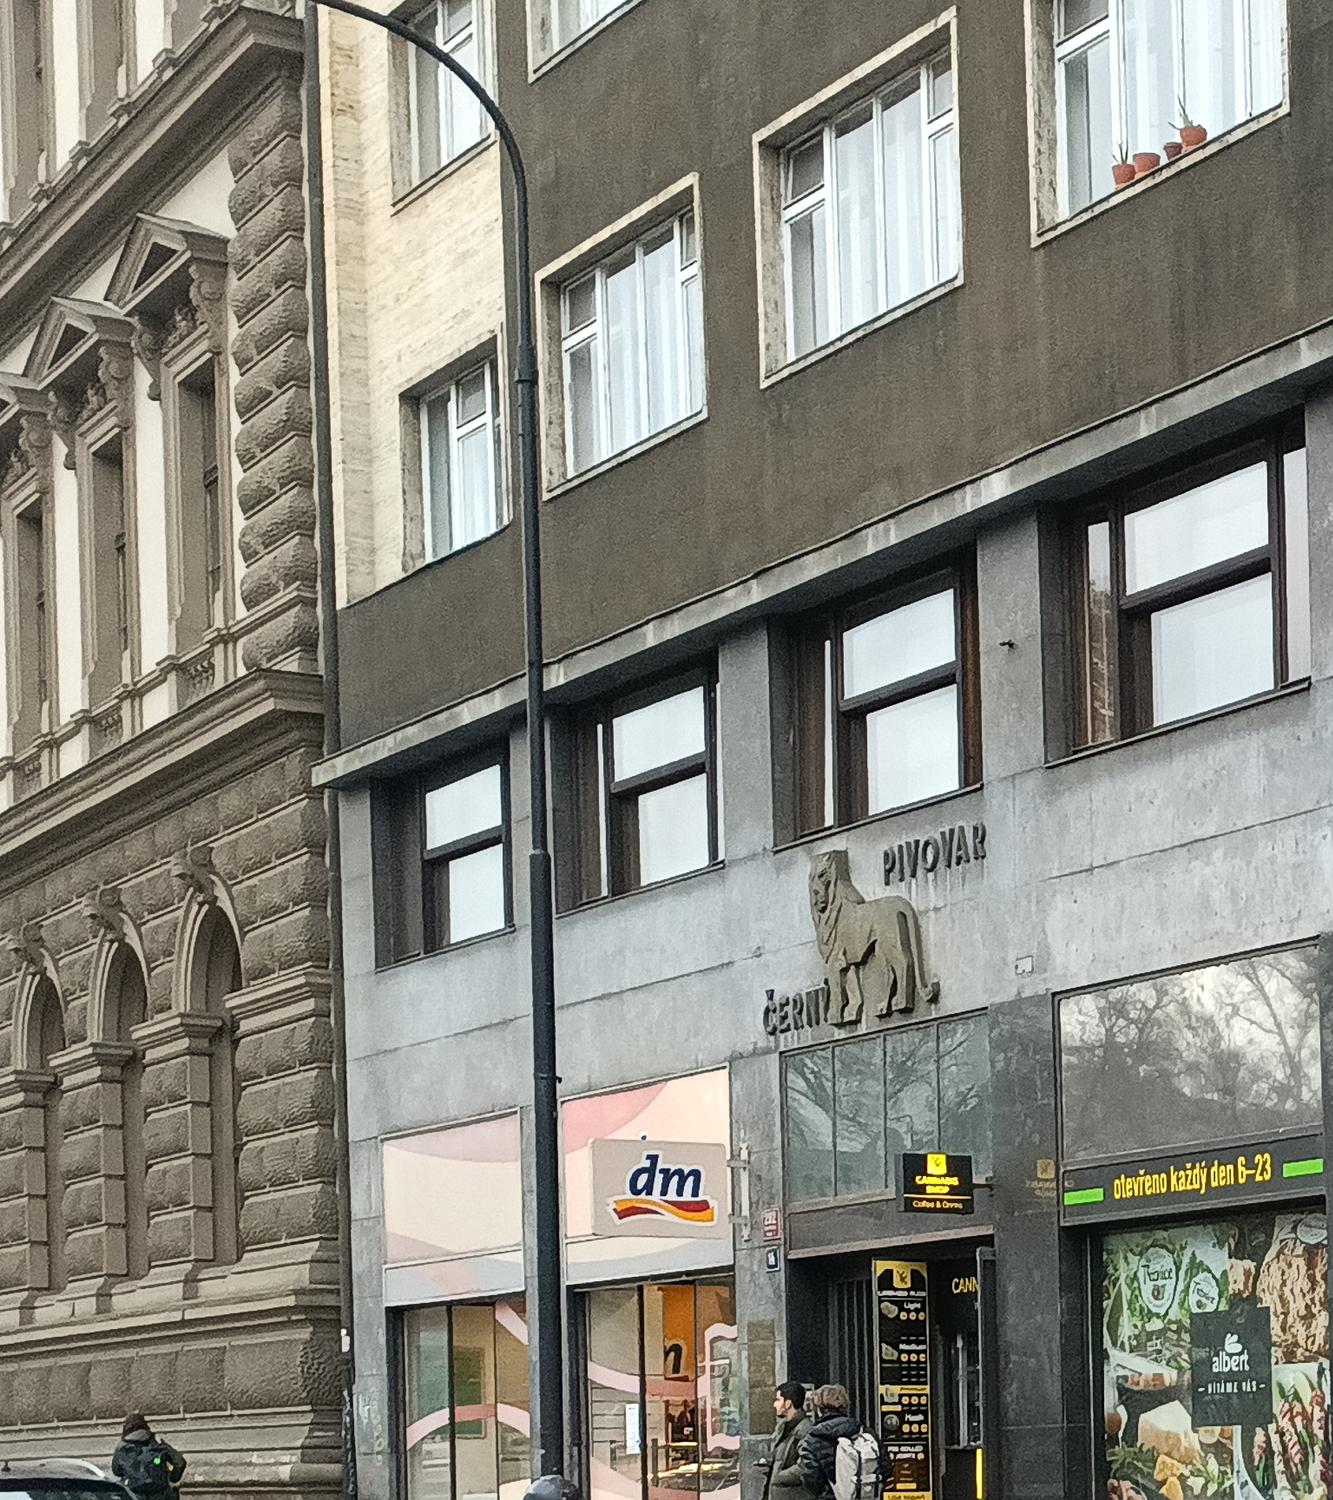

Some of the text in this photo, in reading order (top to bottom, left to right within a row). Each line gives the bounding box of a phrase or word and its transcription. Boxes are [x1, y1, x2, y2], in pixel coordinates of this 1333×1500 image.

[883, 822, 987, 886] PIVOVAR
[629, 1154, 702, 1198] dm
[1113, 1169, 1167, 1200] otevřeno
[1170, 1161, 1207, 1194] každý
[1210, 1160, 1235, 1188] den
[1211, 1349, 1250, 1374] albert
